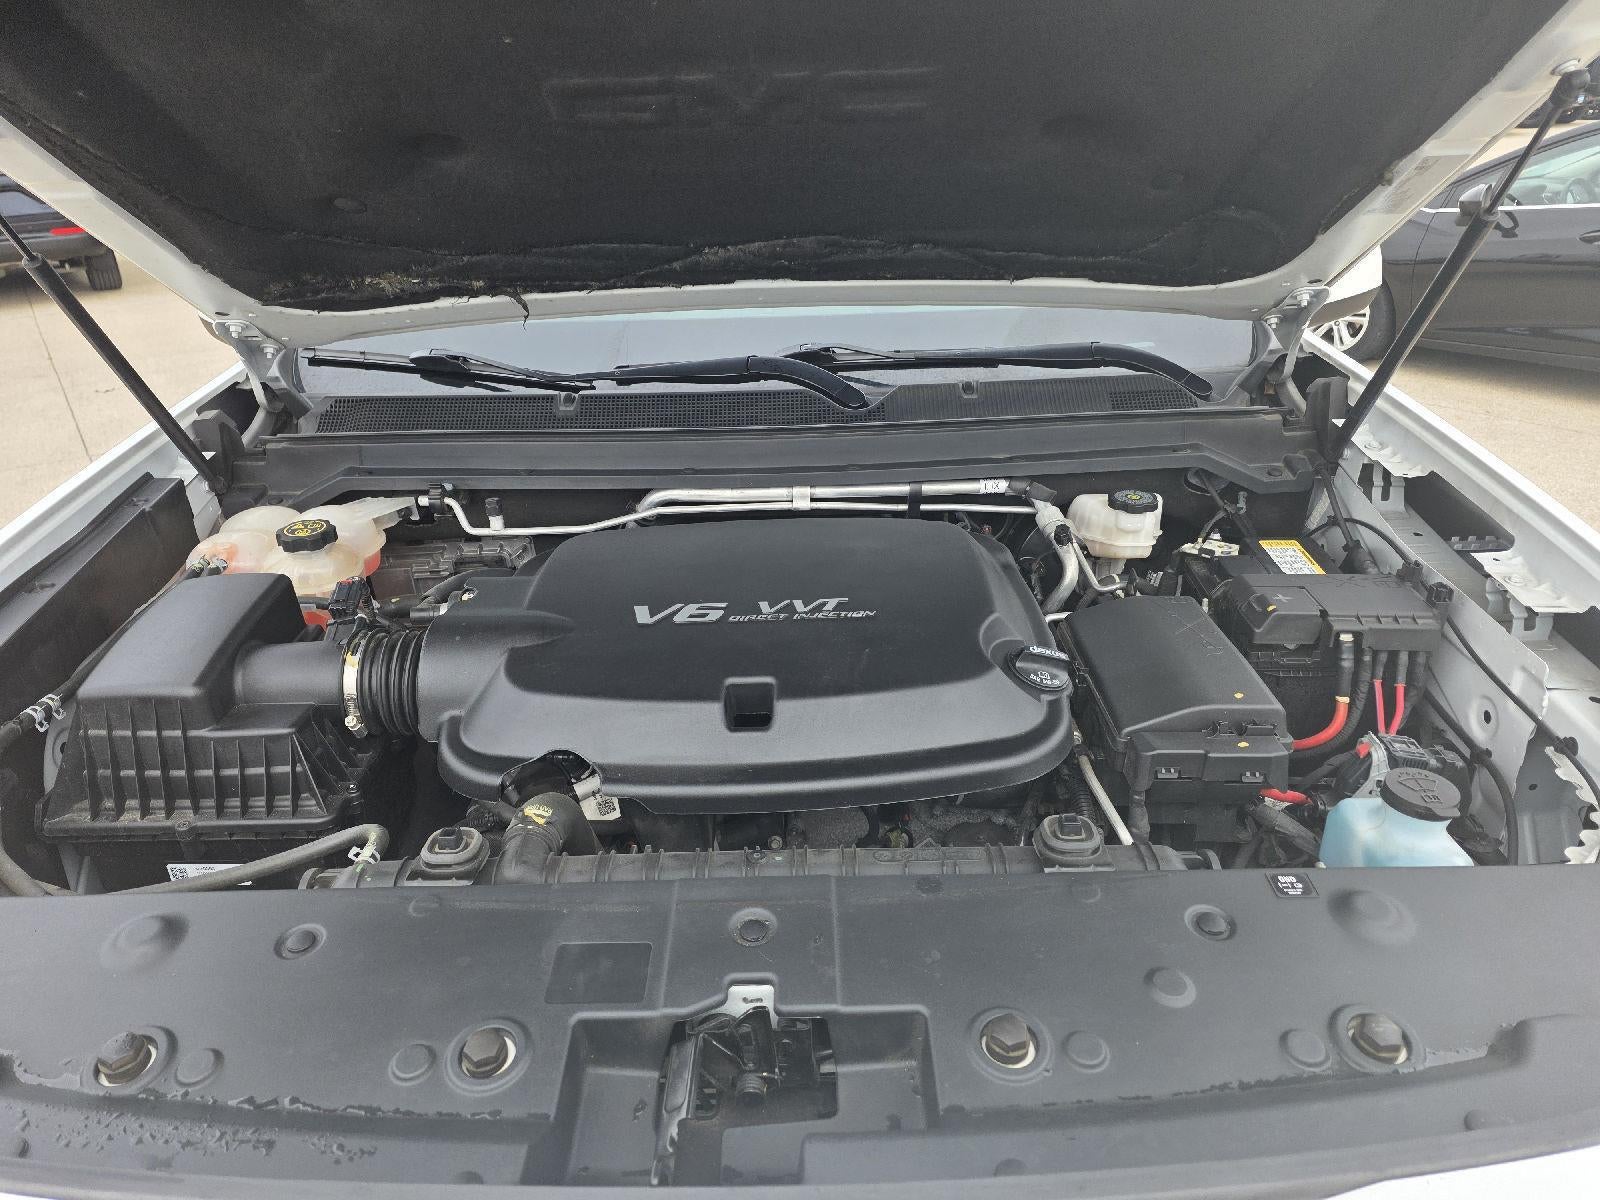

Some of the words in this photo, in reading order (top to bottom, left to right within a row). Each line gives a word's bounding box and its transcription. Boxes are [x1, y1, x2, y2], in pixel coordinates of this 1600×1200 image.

[633, 602, 729, 625] V6
[758, 597, 849, 614] VVT
[728, 613, 790, 623] DIRECT
[792, 610, 878, 620] INJECTION
